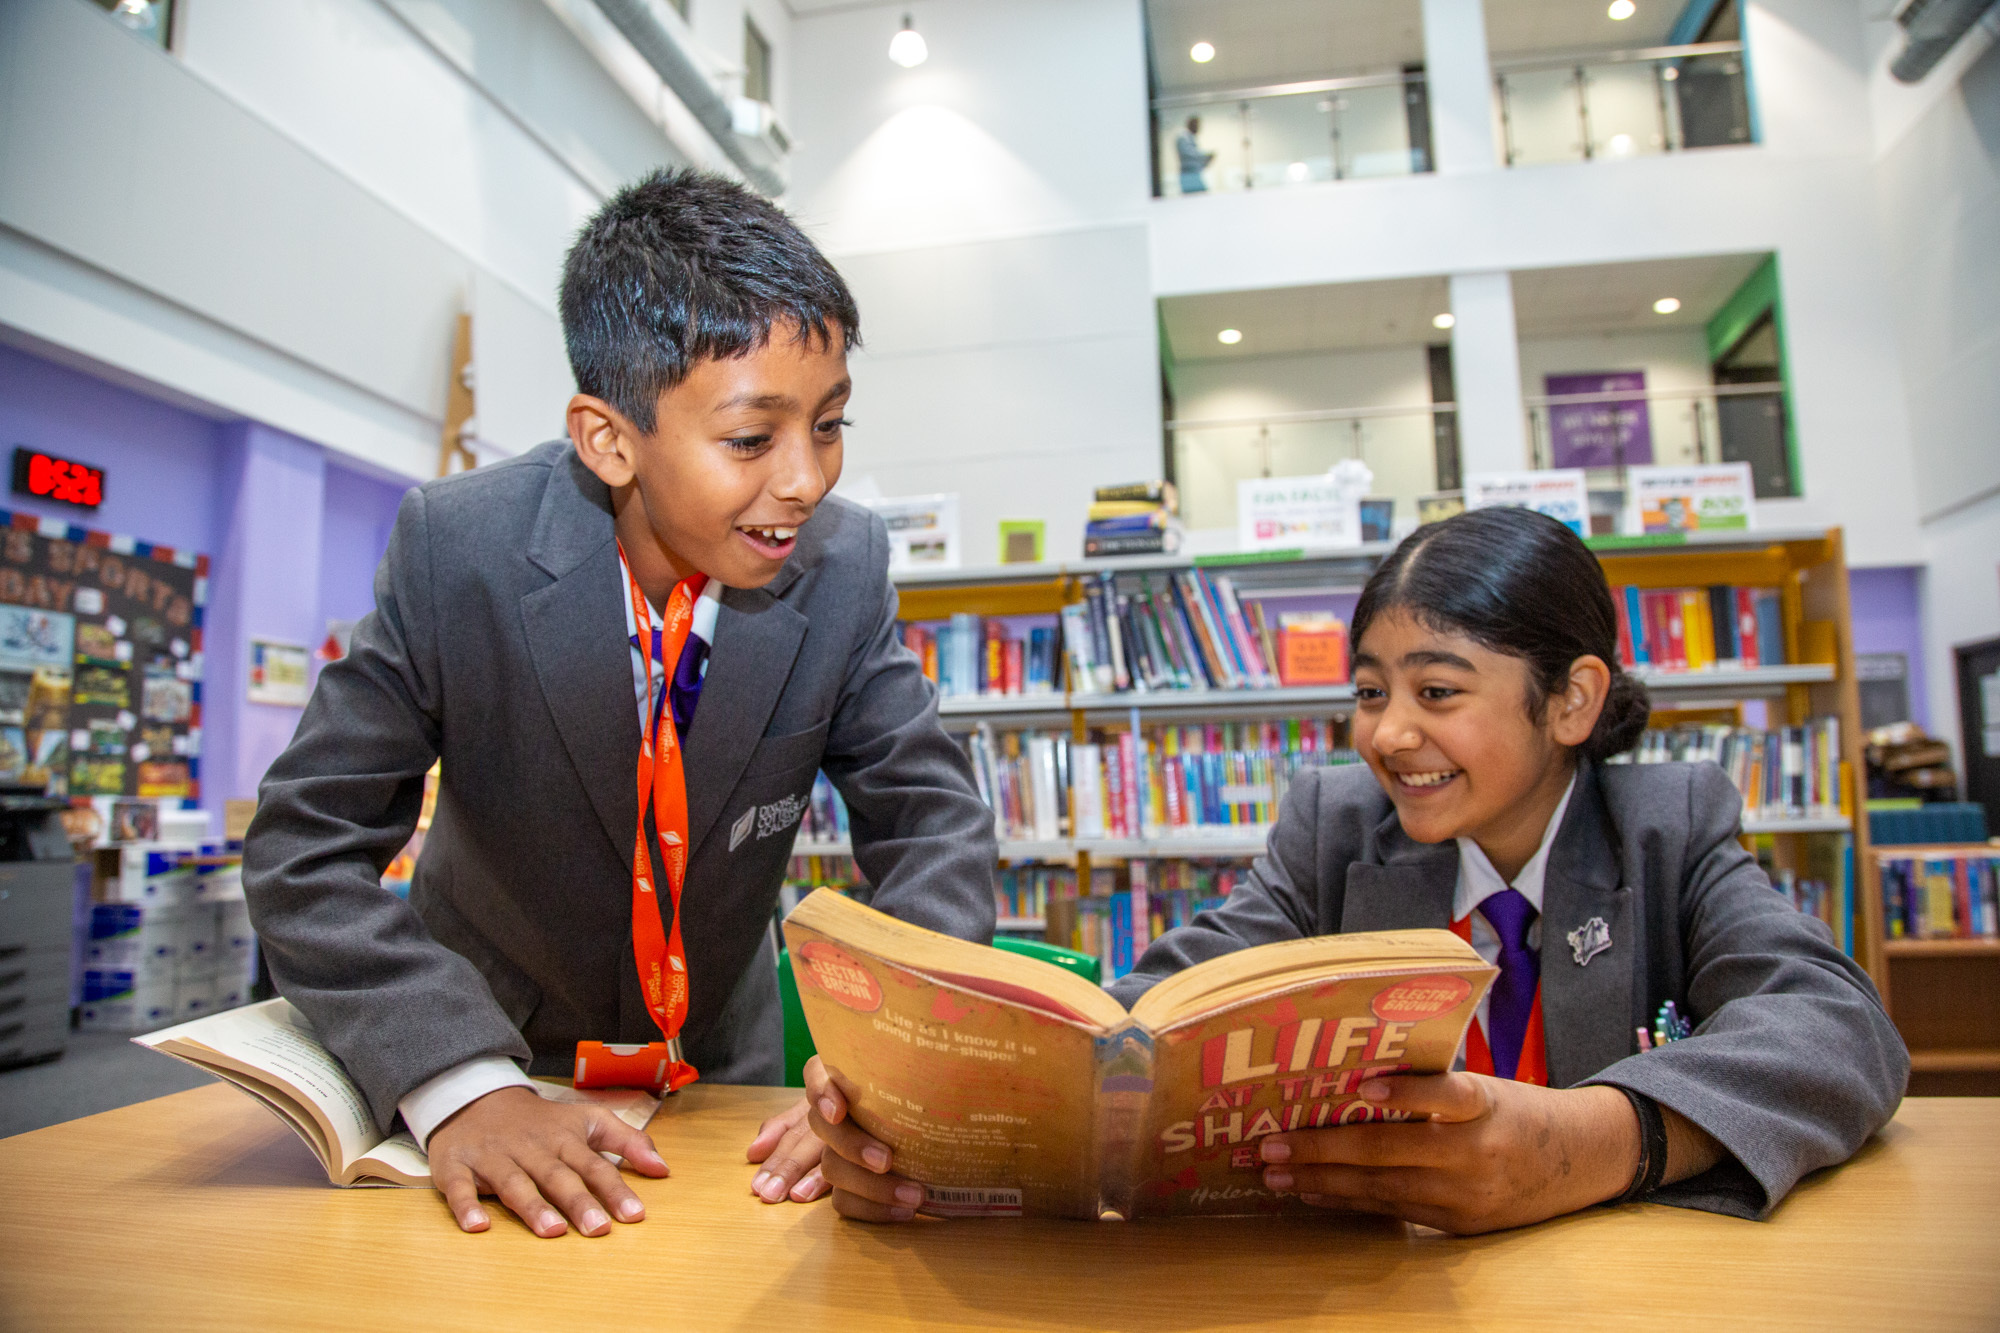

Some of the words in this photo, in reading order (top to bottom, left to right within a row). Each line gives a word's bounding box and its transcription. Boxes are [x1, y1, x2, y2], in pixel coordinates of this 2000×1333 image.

[808, 957, 870, 987] ELECTRA
[820, 973, 873, 1001] BROWN
[1382, 1000, 1444, 1012] BROWN
[1388, 987, 1459, 1001] ELECTRA
[872, 1018, 912, 1043] going
[885, 1008, 914, 1029] Life
[918, 1023, 937, 1037] as
[942, 1029, 949, 1041] I
[954, 1031, 999, 1049] know
[1005, 1040, 1016, 1051] it
[1022, 1043, 1037, 1056] is
[1203, 1017, 1416, 1087] LIFE
[878, 1089, 902, 1106] can
[906, 1099, 924, 1113] be
[969, 1111, 1032, 1125] shallow.
[1199, 1083, 1262, 1113] AT
